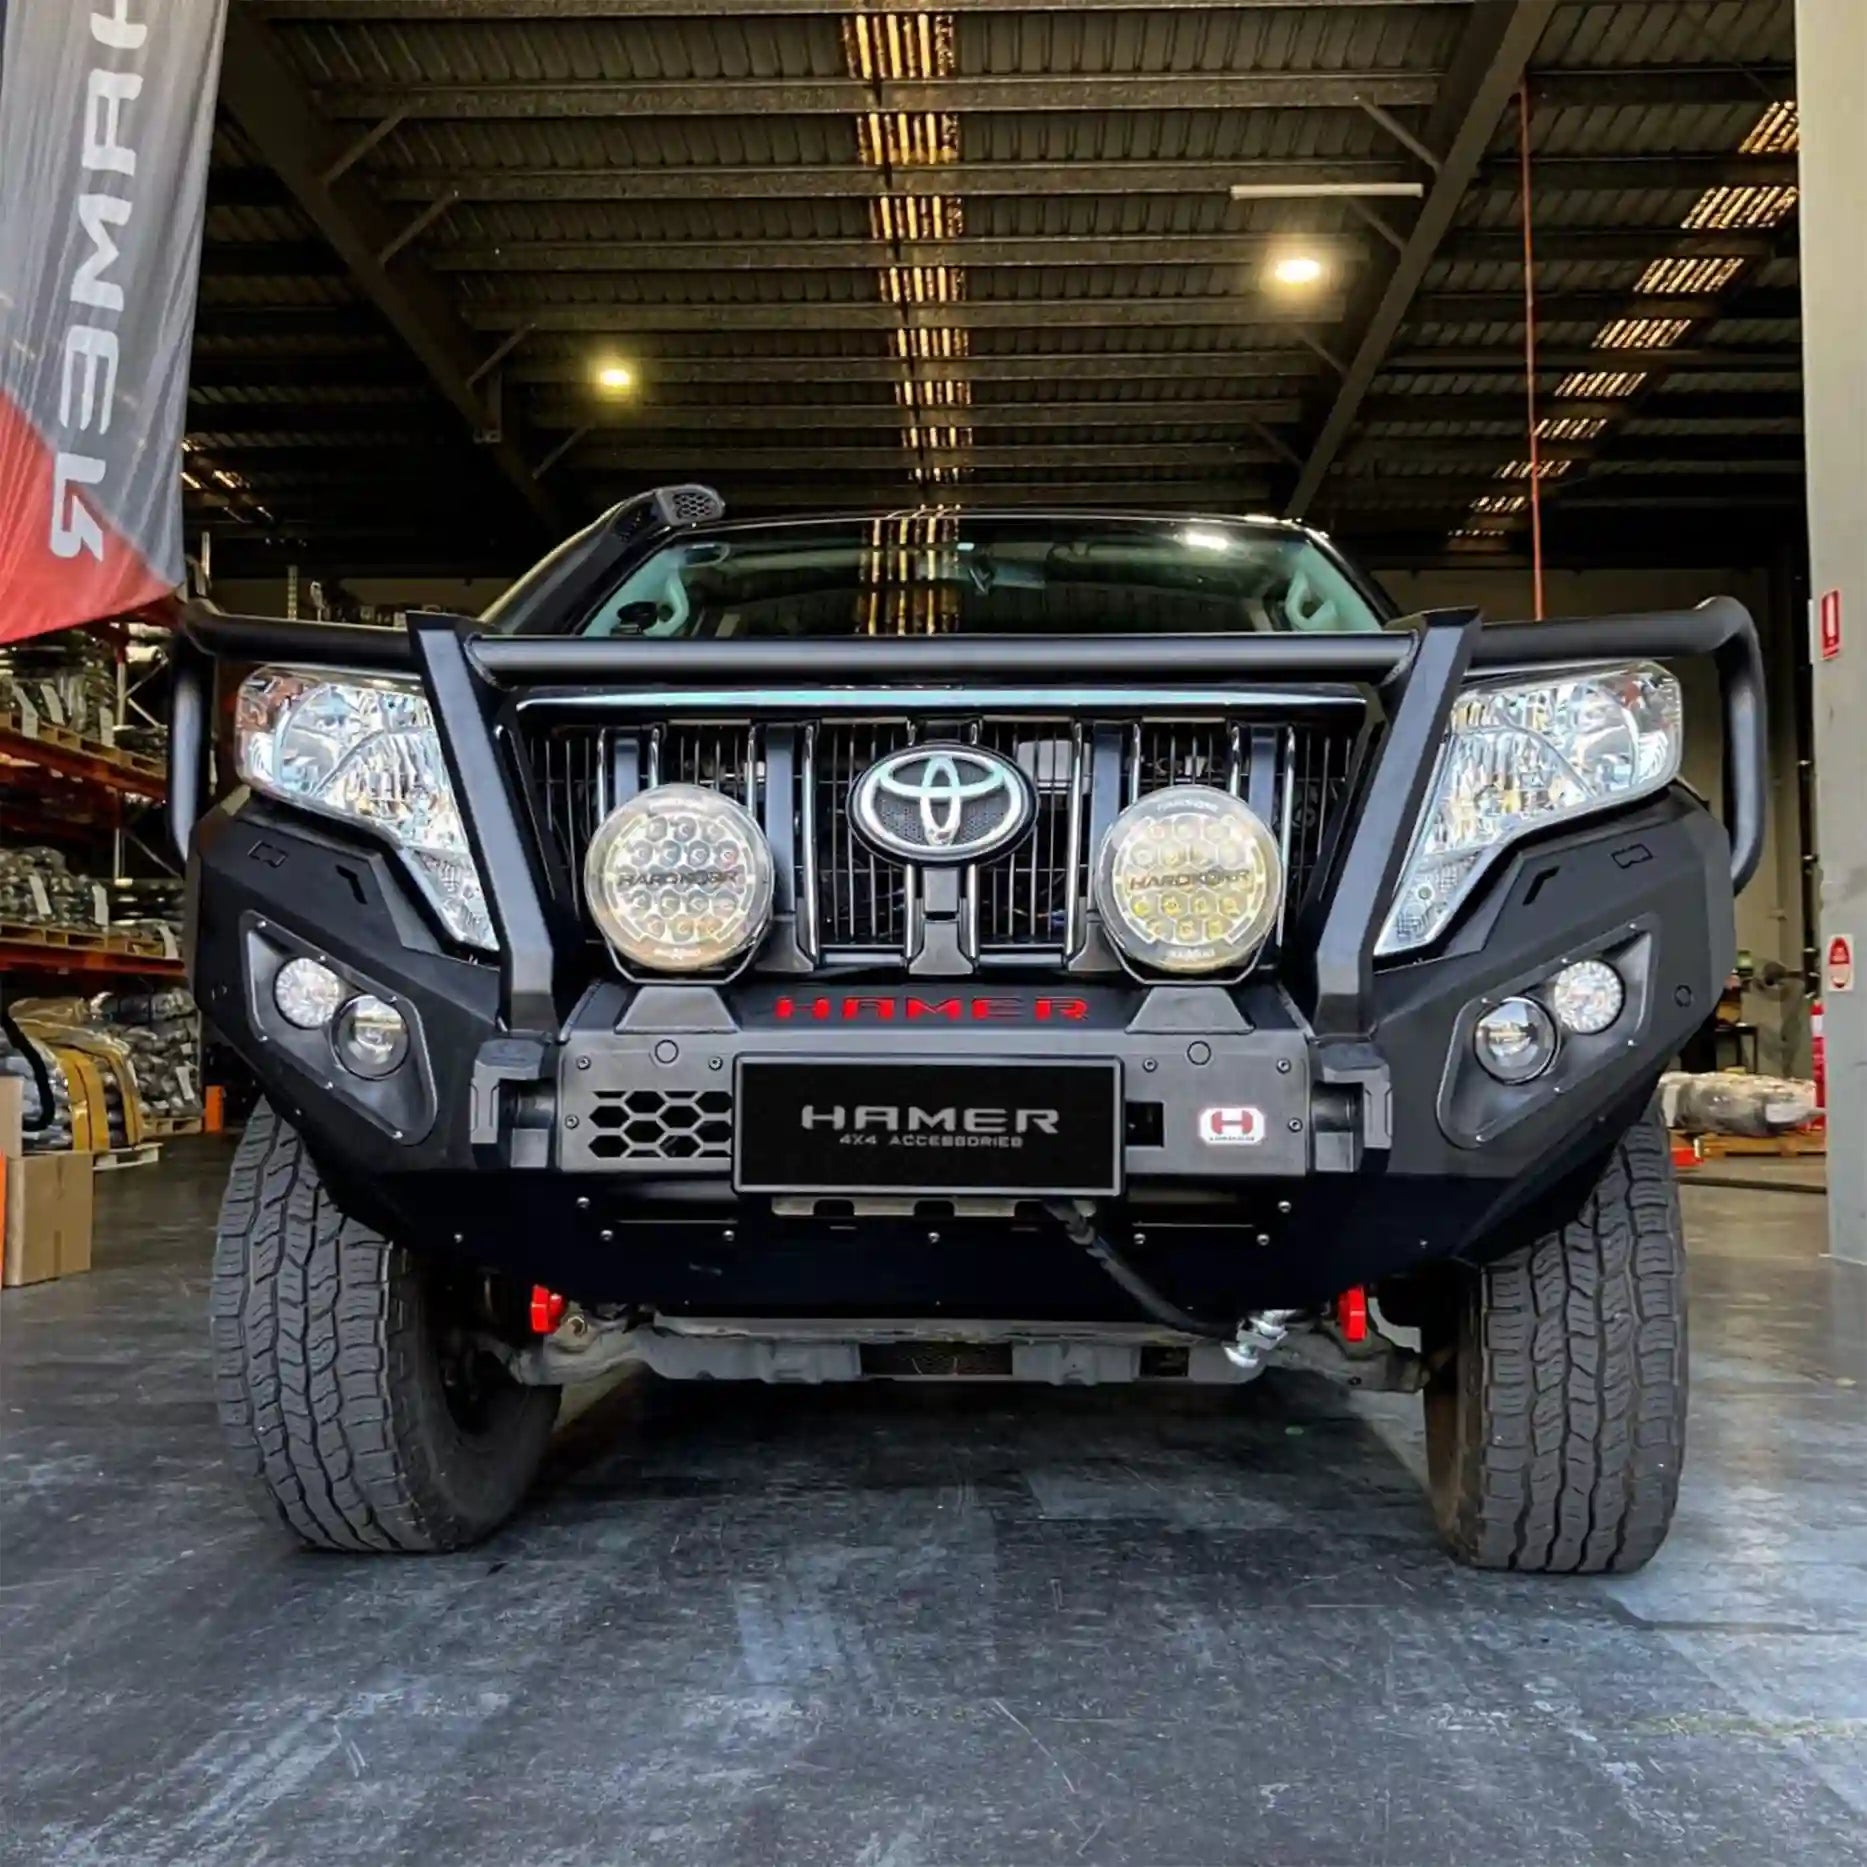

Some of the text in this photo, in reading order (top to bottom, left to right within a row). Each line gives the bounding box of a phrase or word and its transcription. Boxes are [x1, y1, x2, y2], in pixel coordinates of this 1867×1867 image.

[775, 996, 1089, 1021] HAMER
[801, 1104, 1060, 1134] HAMER
[839, 1134, 1024, 1148] 4X4 ACCESSORIES
